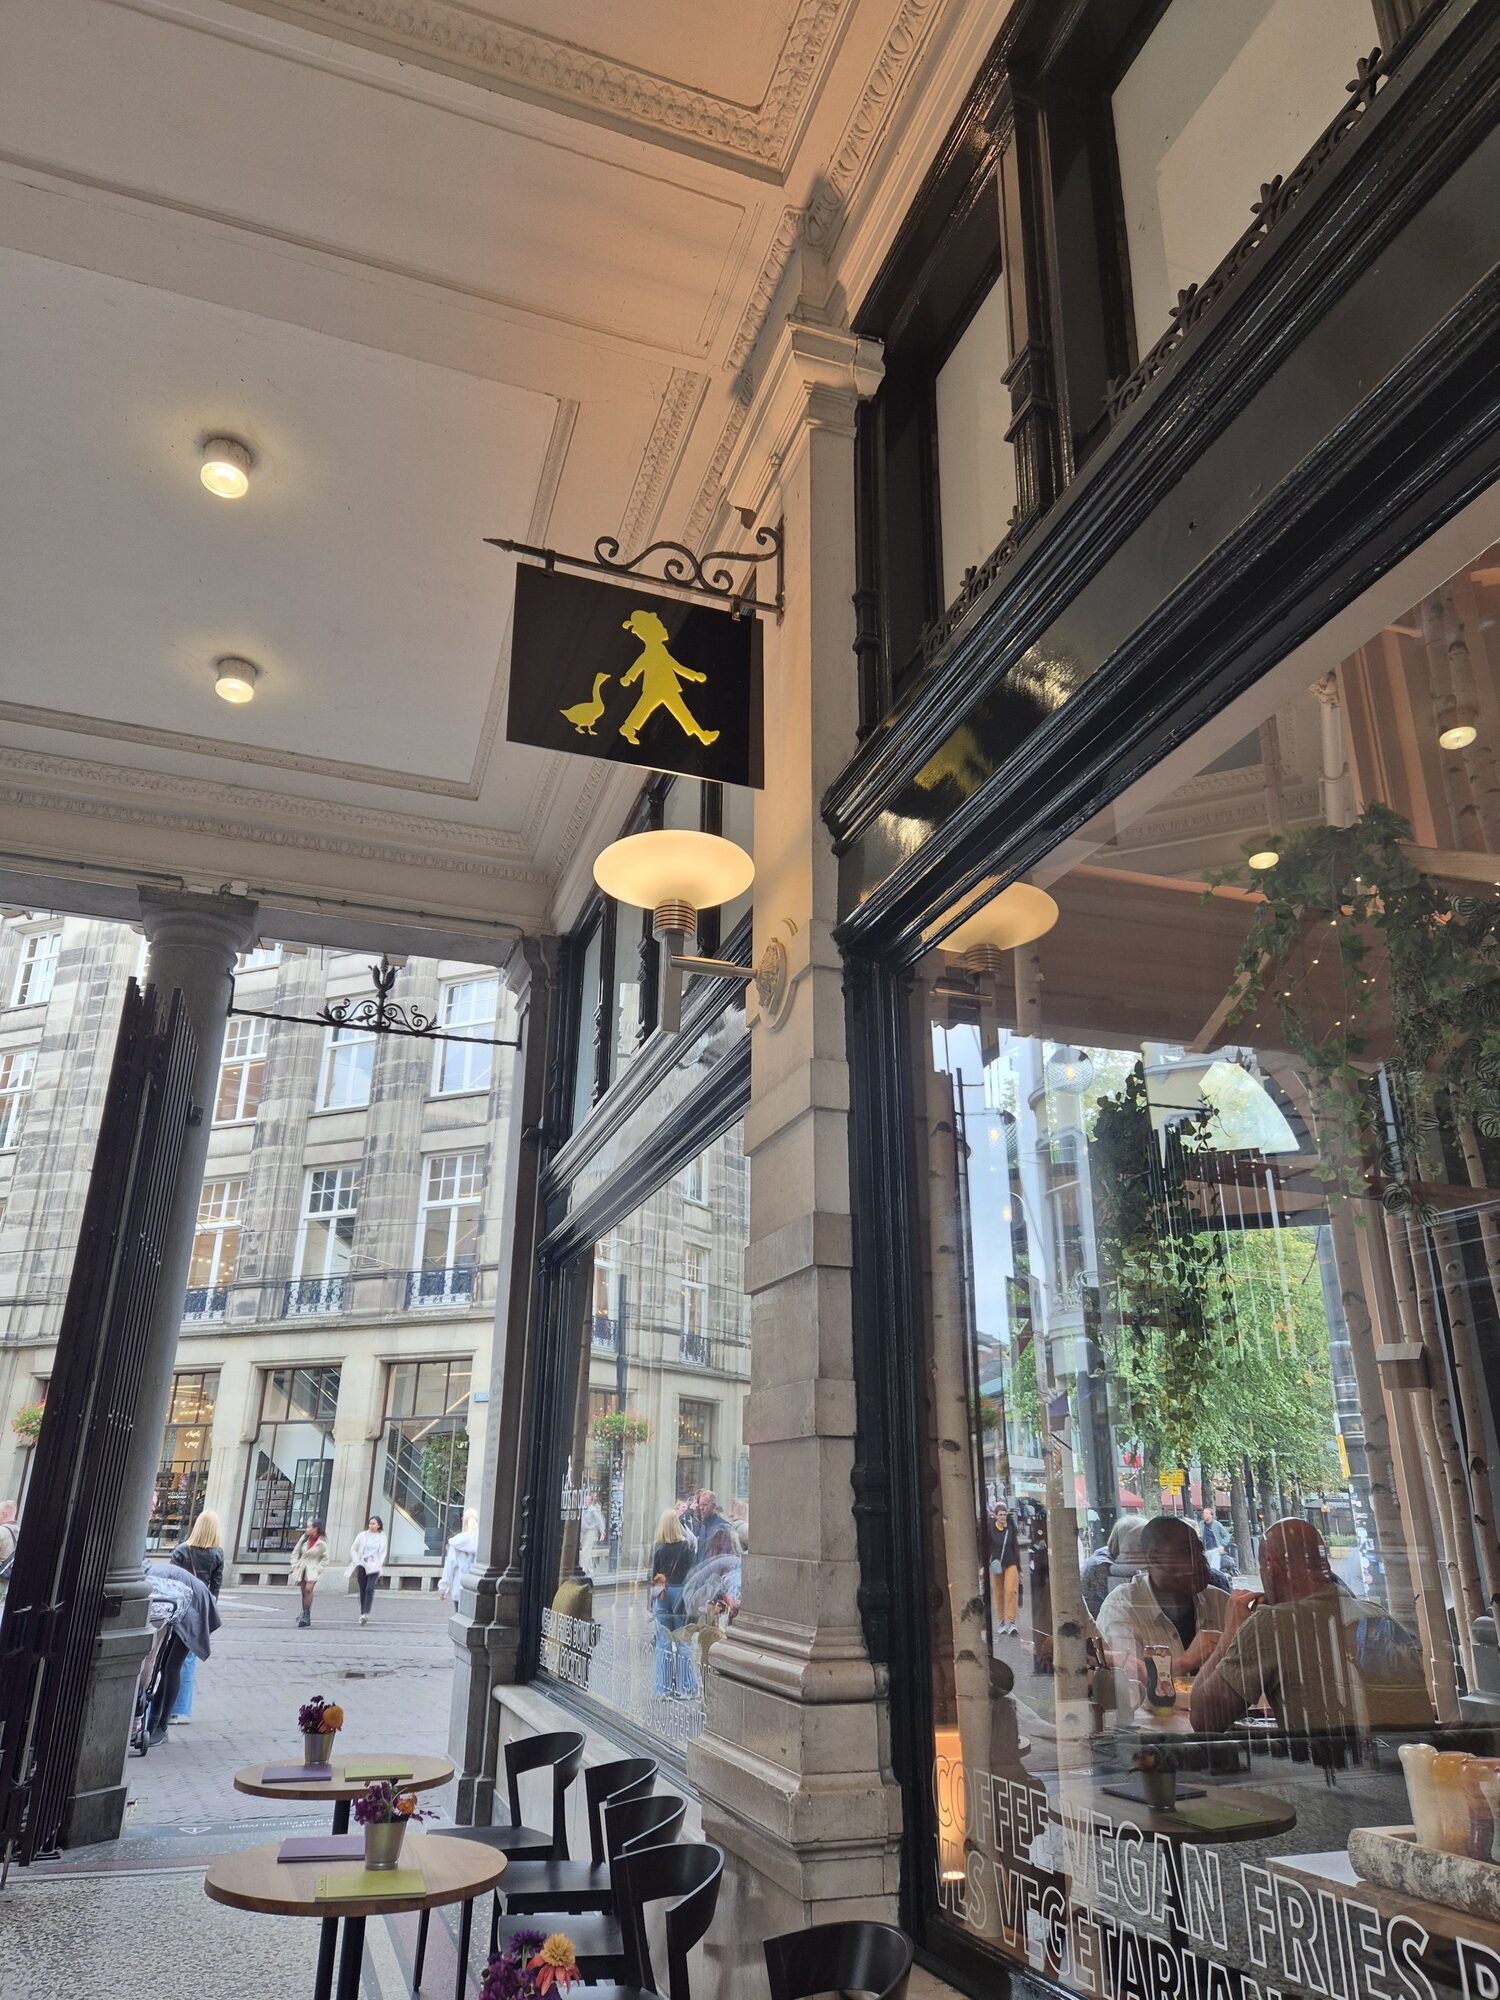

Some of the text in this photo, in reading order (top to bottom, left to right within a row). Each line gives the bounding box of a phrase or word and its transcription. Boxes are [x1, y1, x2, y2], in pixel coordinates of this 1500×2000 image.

[932, 1755, 1054, 1874] COFFEE
[1060, 1801, 1228, 1951] VEGAN
[1240, 1862, 1438, 2000] FRIES
[992, 1861, 1283, 2000] VEGETARI
